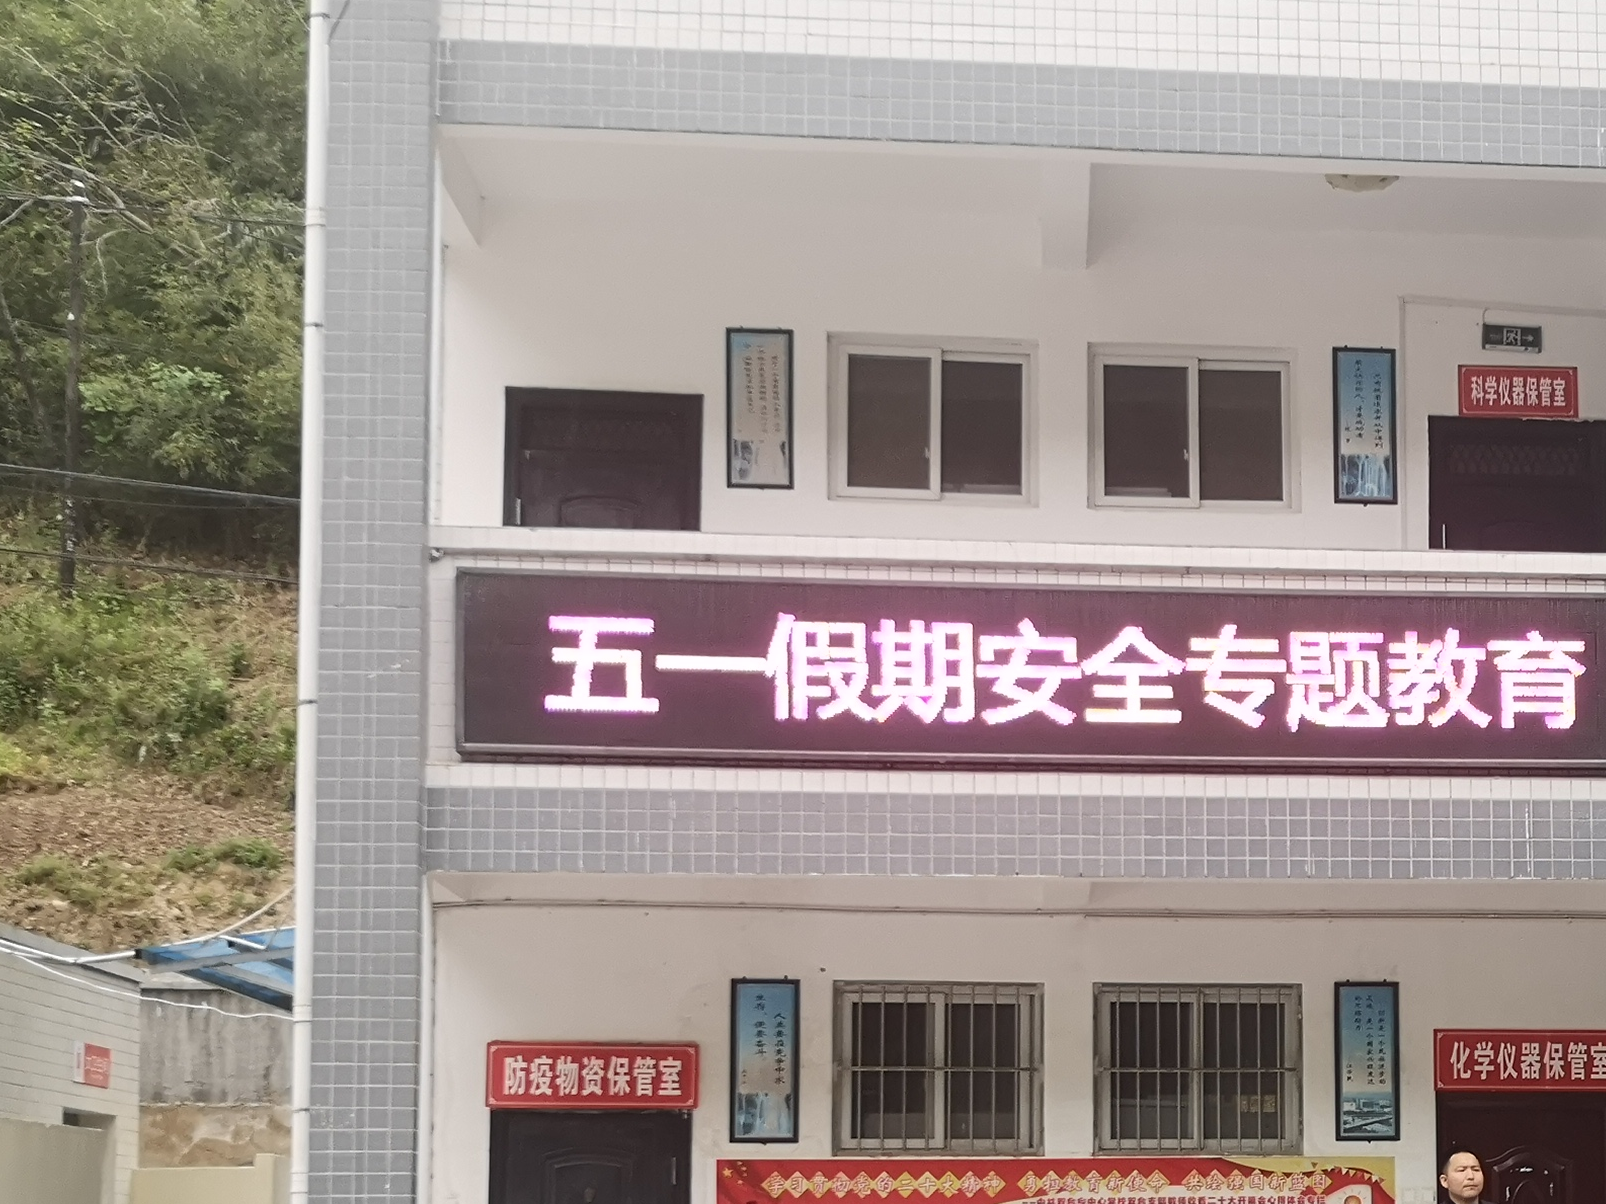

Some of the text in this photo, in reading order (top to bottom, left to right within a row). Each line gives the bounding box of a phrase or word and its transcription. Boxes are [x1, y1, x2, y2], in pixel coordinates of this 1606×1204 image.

[1471, 375, 1566, 407] 科学仪器保管室
[543, 611, 1588, 732] 五一假期安全专题教育
[503, 1055, 682, 1097] 防疫物资保管室
[767, 1172, 1327, 1197] 学习贯彻党的二十大精神 勇担教育新使命 共绘强国新蓝图
